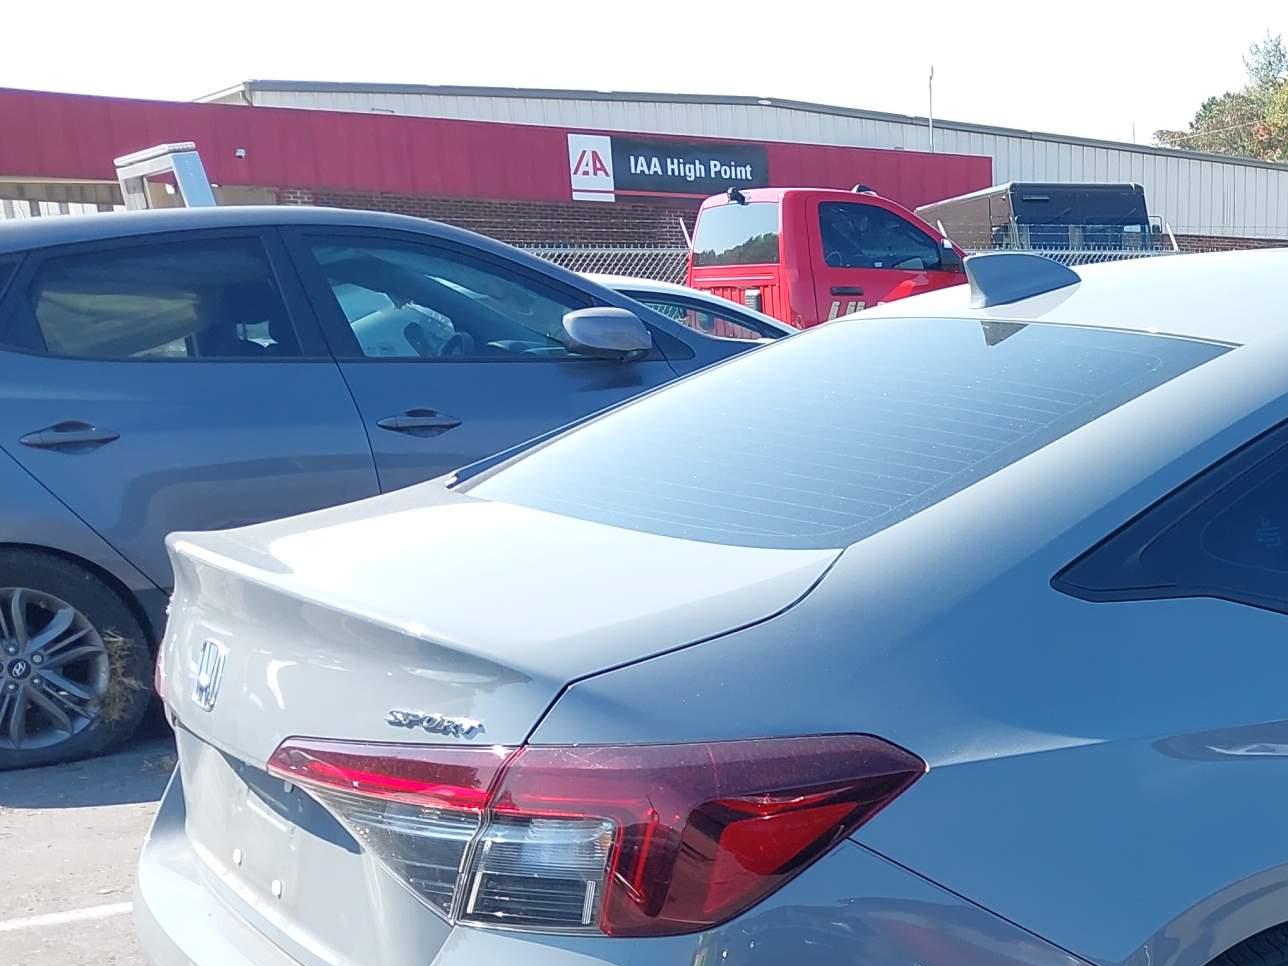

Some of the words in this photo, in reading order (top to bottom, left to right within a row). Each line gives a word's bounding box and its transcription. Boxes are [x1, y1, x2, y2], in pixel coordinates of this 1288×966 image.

[629, 155, 663, 175] IAA
[667, 158, 705, 182] High
[710, 160, 753, 181] Point
[385, 709, 486, 741] SPORT
